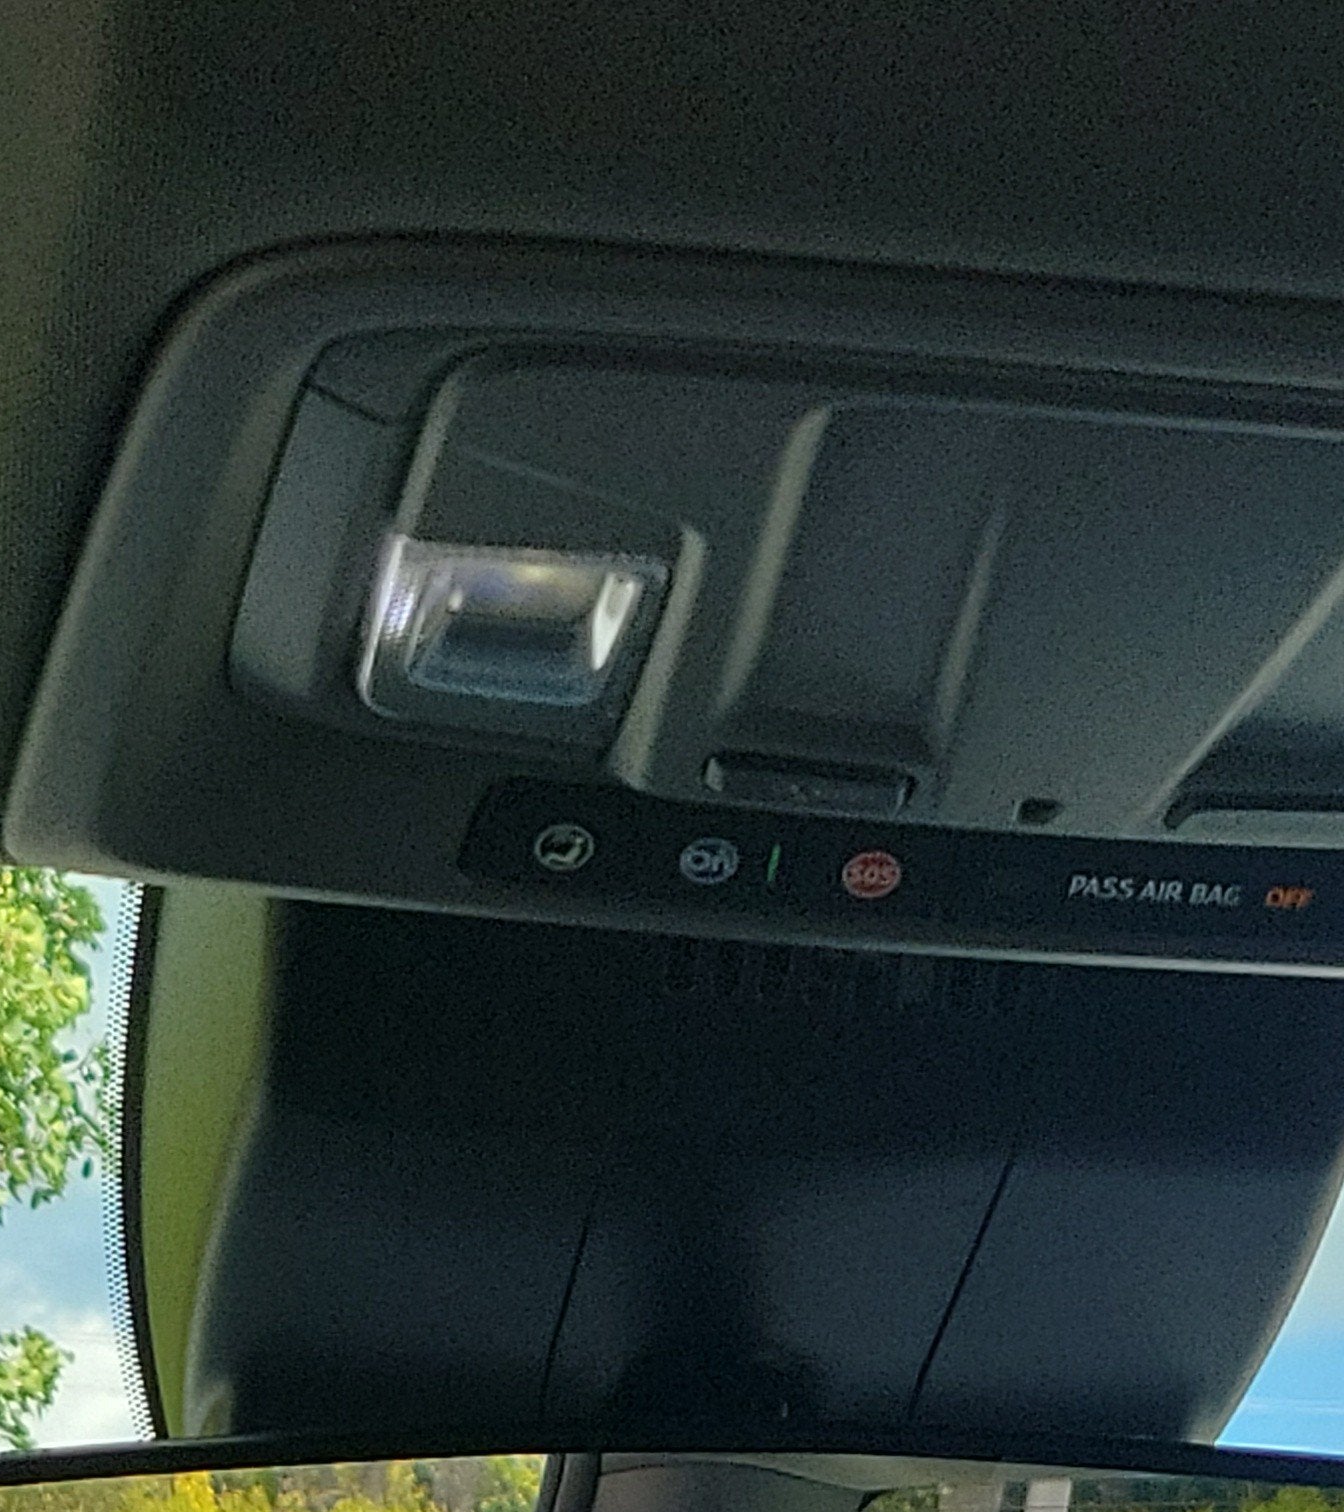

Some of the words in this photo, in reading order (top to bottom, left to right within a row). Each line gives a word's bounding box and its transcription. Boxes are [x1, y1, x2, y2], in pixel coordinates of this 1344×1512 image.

[846, 863, 897, 885] SOS
[1068, 874, 1134, 899] PASS
[1139, 879, 1183, 903] AIR
[1189, 883, 1242, 906] BAG
[1264, 886, 1315, 910] OFF
